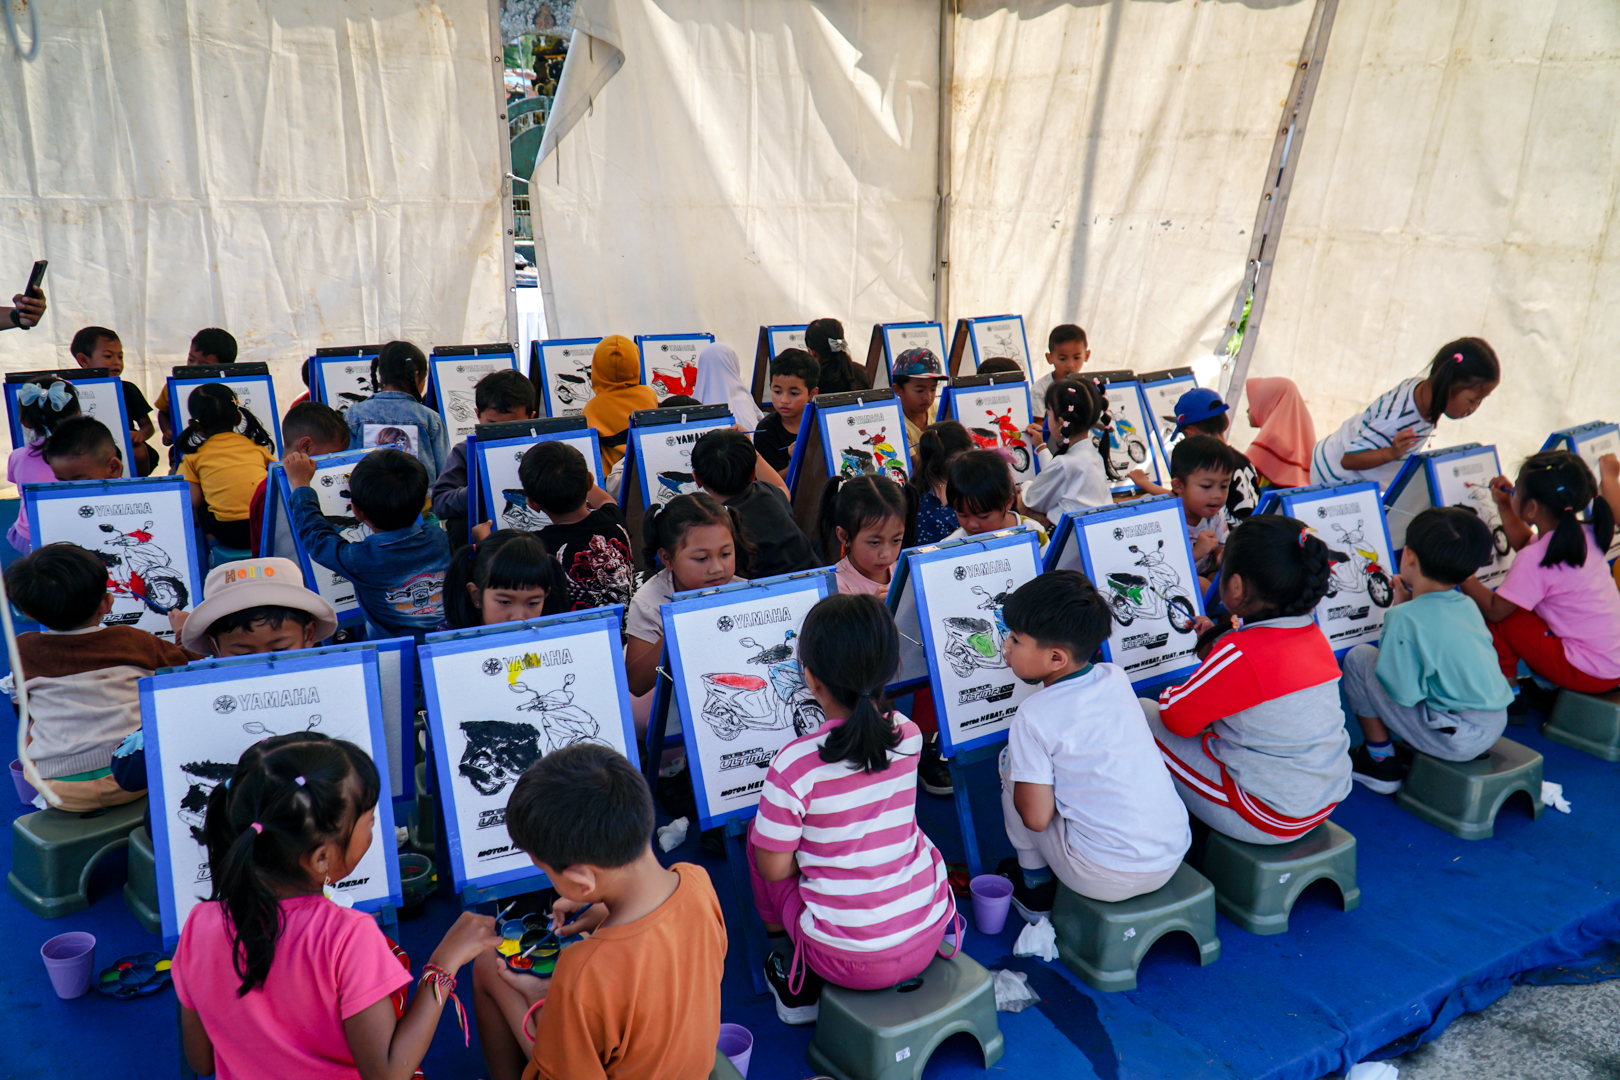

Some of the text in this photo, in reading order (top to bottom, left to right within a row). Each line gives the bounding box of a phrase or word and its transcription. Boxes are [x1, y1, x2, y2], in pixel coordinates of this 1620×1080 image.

[983, 395, 1011, 406] YAMAHA
[855, 413, 885, 425] YAMAHA
[95, 502, 152, 518] YAMAHA
[1326, 502, 1361, 518] YAMAHA
[1122, 521, 1162, 539] YAMAHA
[966, 558, 1011, 579] YAMAHA
[734, 606, 792, 631] YAMAHA
[503, 648, 574, 673] YAMAHA
[1140, 655, 1162, 666] HEBAT,
[1161, 651, 1179, 661] KUAT,
[237, 686, 321, 712] YAMAHA
[720, 749, 775, 771] ULTIMA
[720, 785, 747, 798] MOTOR
[477, 845, 510, 858] MOTOR
